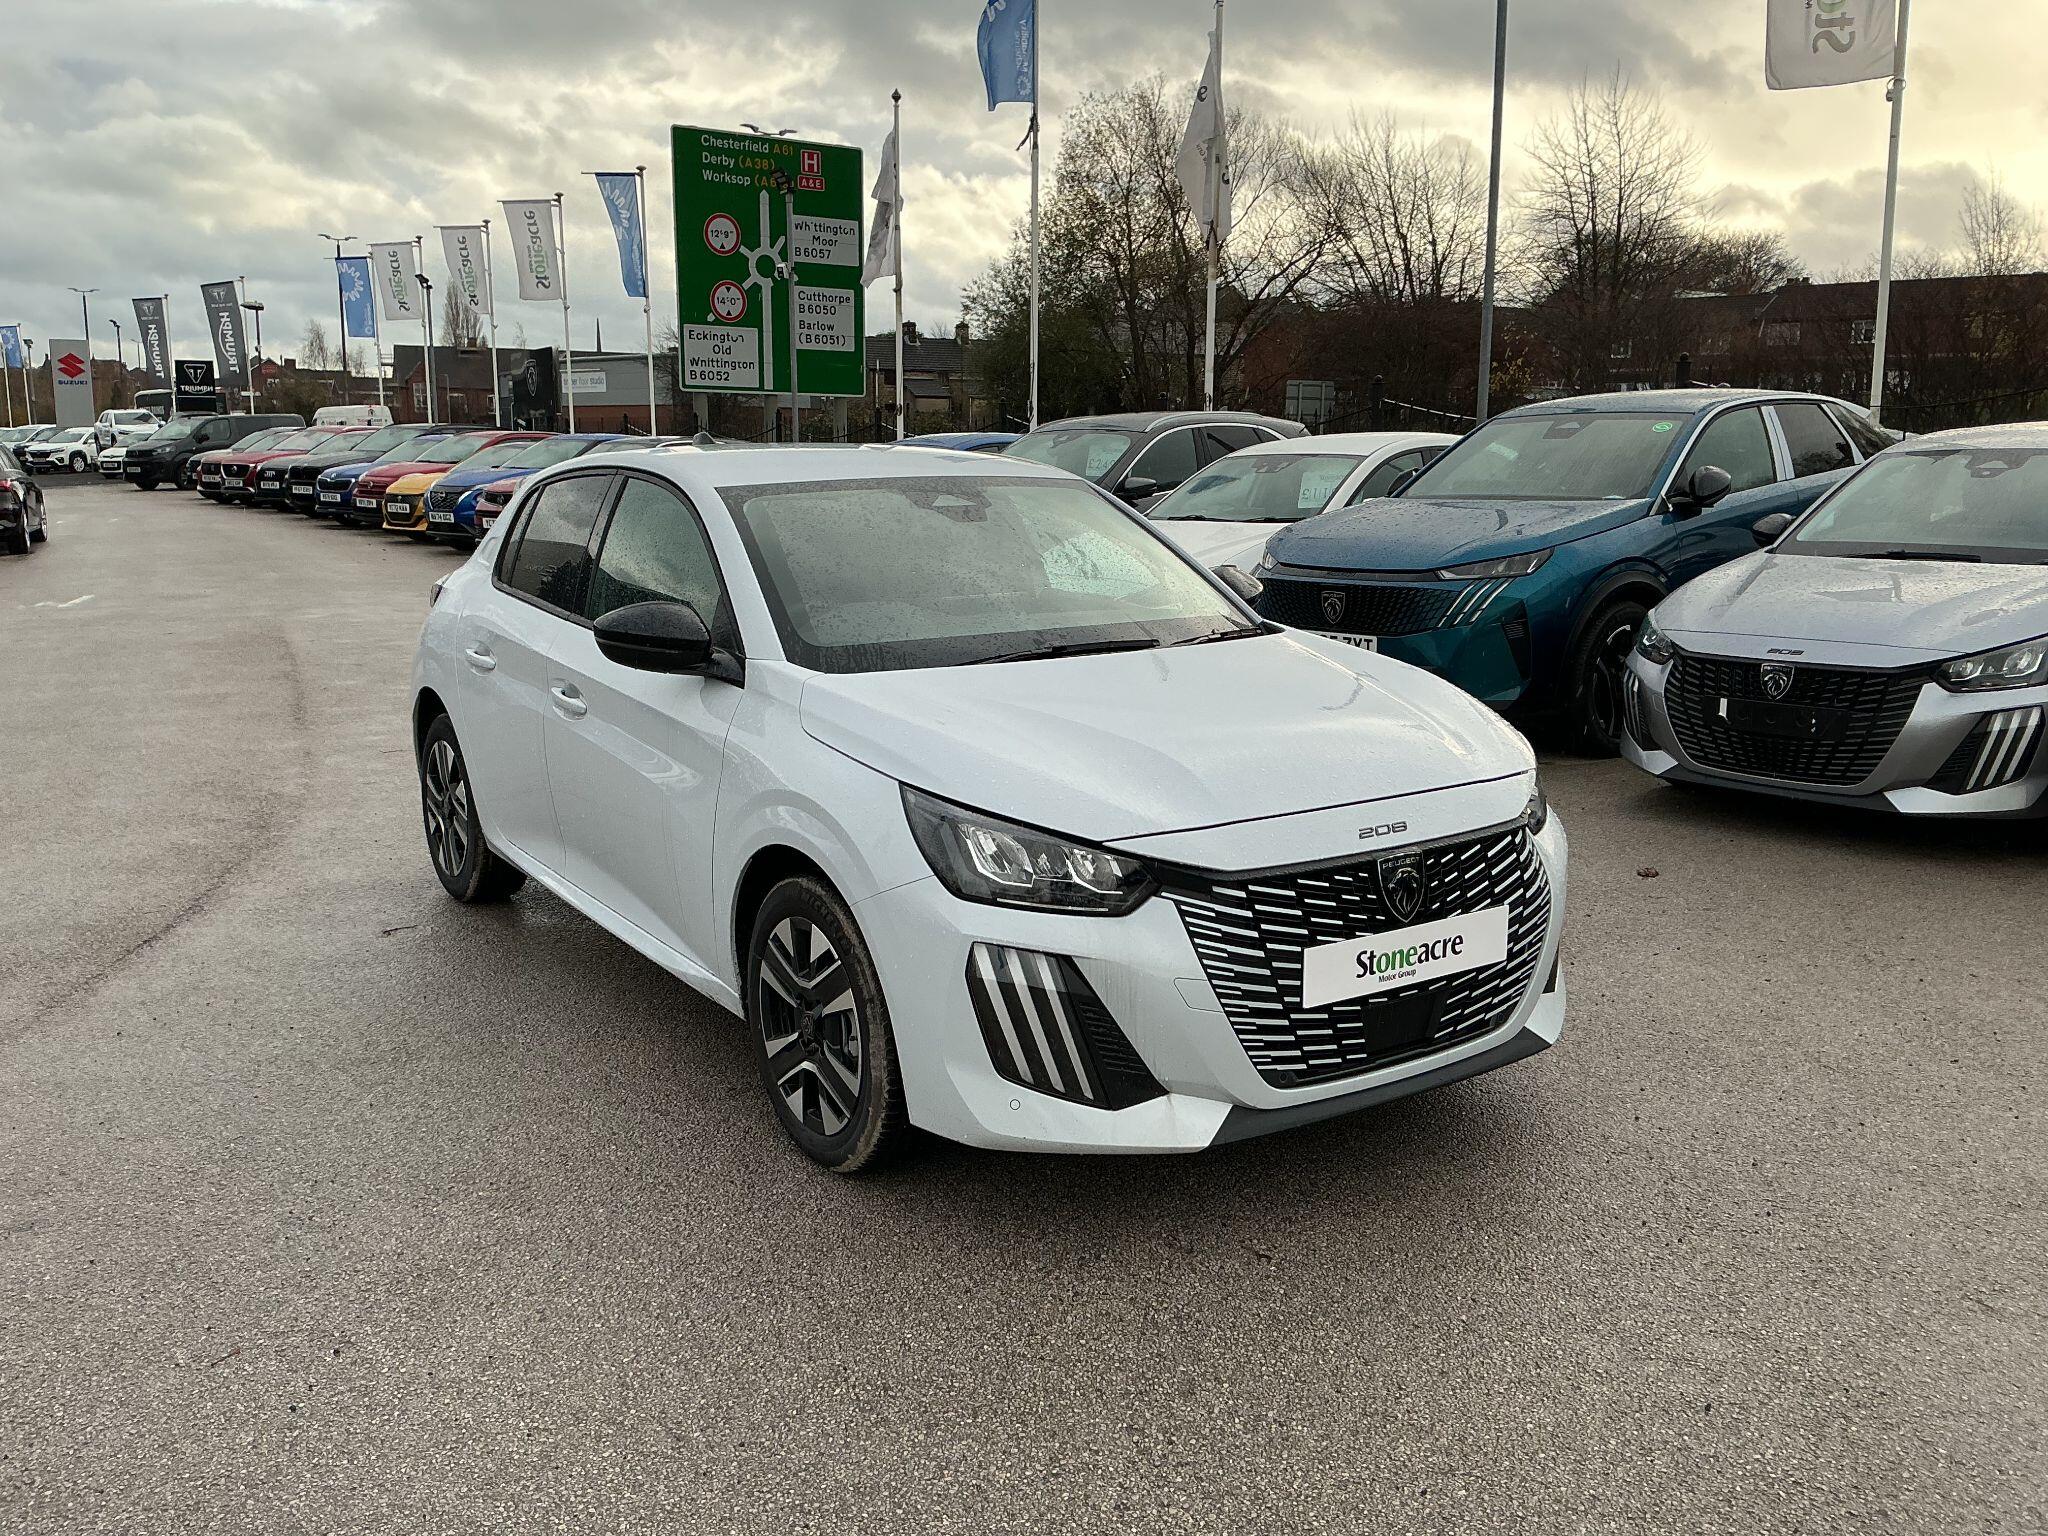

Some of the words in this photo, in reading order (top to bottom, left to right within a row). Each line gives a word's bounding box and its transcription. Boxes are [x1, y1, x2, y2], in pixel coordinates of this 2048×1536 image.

[701, 134, 770, 154] Chesterfield
[773, 143, 794, 156] A61
[702, 152, 735, 169] Derby
[738, 157, 775, 170] (A38)
[804, 152, 818, 173] H
[702, 169, 751, 187] Worksop
[801, 179, 822, 189] A&E
[812, 235, 839, 247] Moor
[798, 290, 851, 305] Cutthorpe
[798, 320, 835, 331] Barlow
[688, 329, 745, 344] Eckington
[712, 344, 732, 355] Old
[689, 356, 755, 371] Whittington
[1358, 821, 1408, 841] 208
[1382, 856, 1420, 870] PEUGEOT
[1355, 932, 1464, 979] Stoneacre
[1378, 972, 1397, 984] Motor
[1397, 968, 1417, 982] Group
